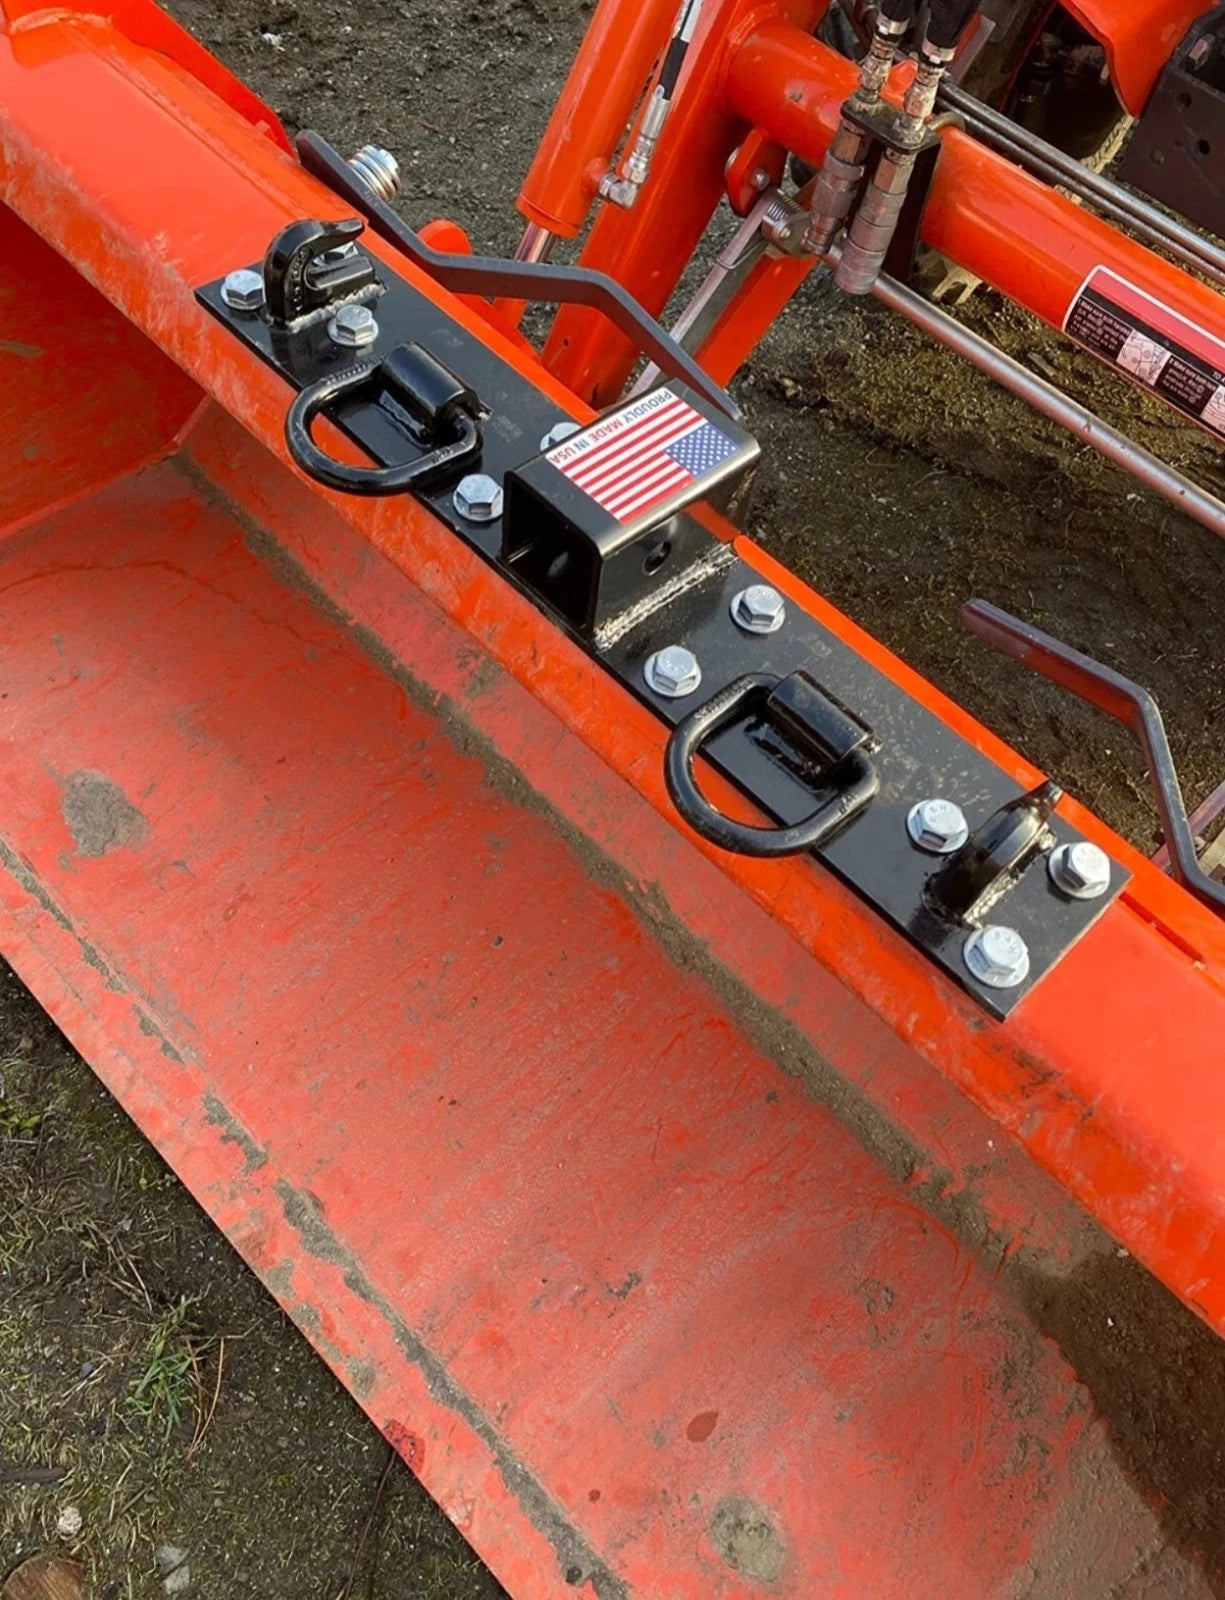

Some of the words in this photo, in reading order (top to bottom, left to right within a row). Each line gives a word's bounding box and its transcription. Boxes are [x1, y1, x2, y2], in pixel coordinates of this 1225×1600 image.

[623, 390, 673, 424] PROUDLY
[590, 419, 623, 443] MADE
[549, 446, 576, 464] USA
[573, 438, 590, 452] IN
